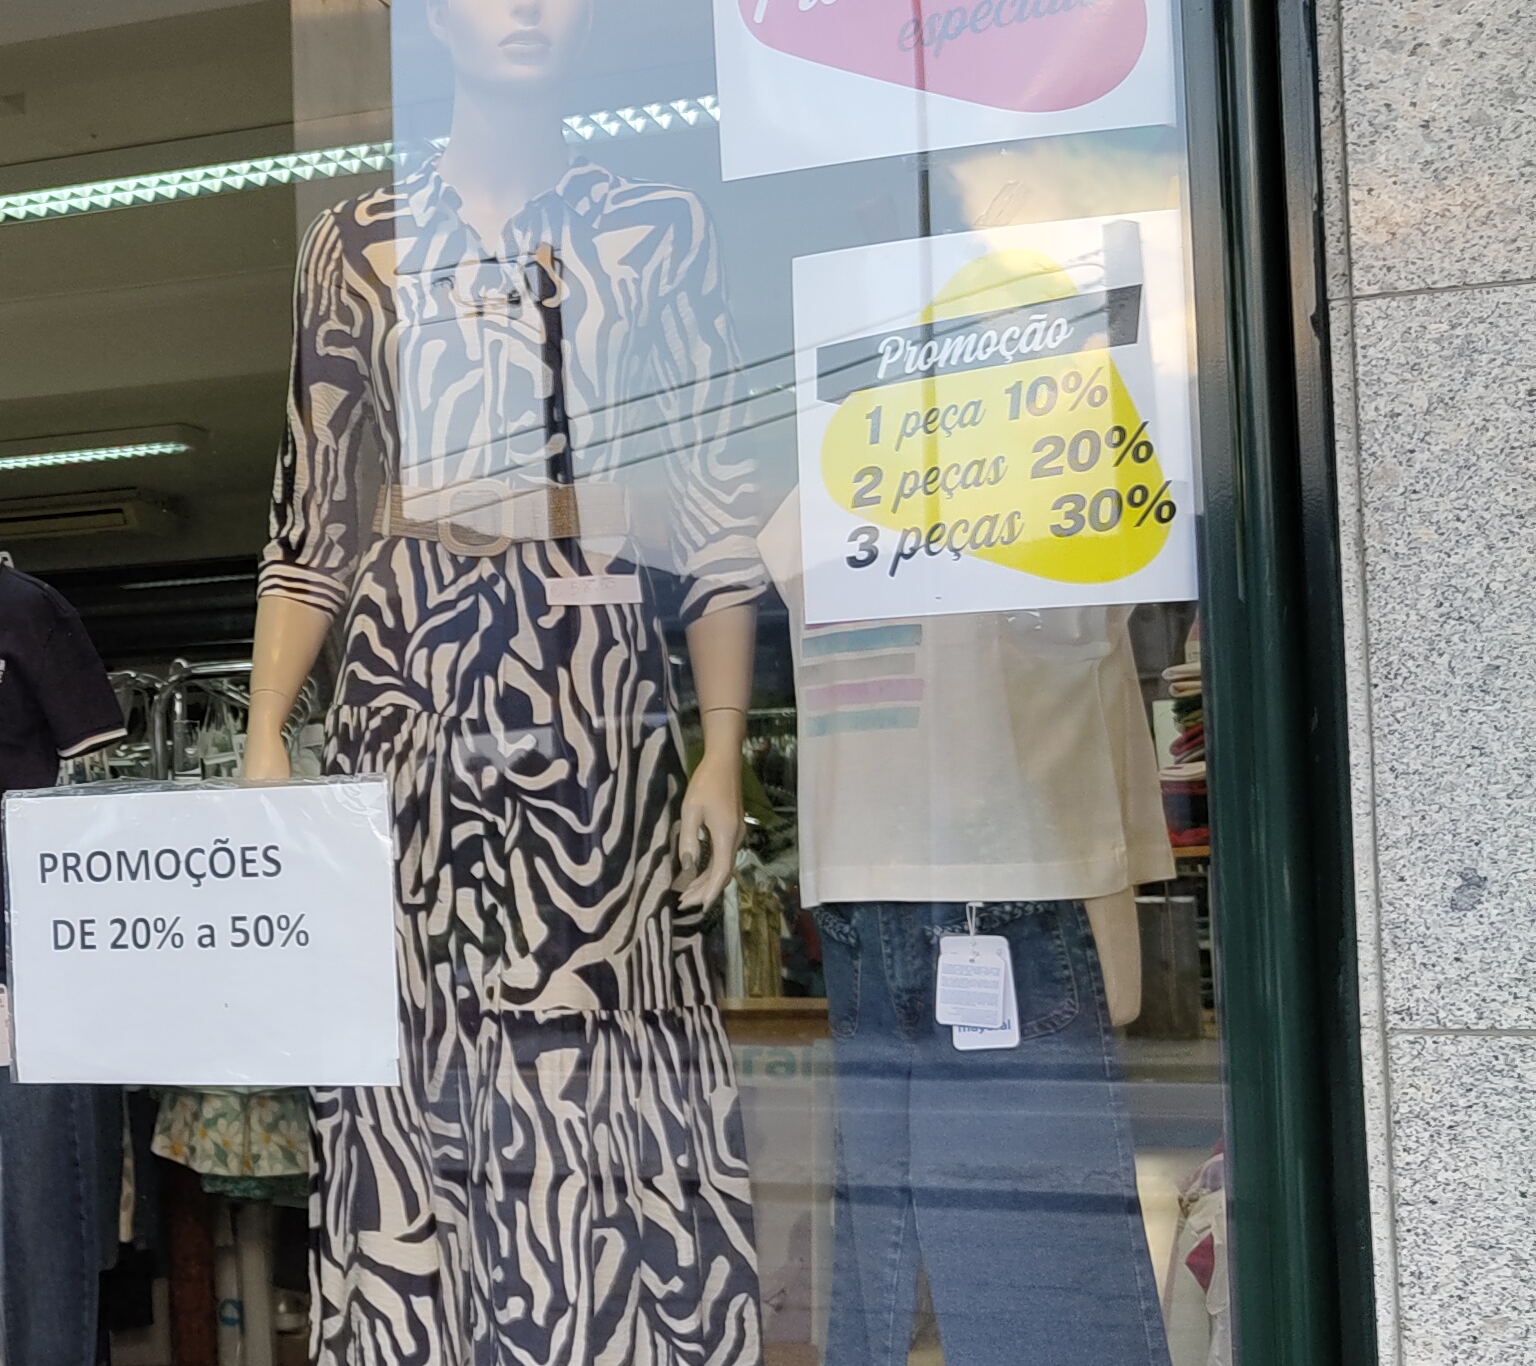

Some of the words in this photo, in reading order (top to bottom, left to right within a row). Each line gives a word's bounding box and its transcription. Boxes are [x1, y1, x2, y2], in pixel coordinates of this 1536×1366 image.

[876, 313, 1073, 379] Promoção
[865, 405, 882, 445] 1
[895, 398, 986, 452] peça
[1003, 366, 1109, 422] 10%
[851, 466, 884, 509] 2
[891, 454, 1008, 514] peças
[1030, 420, 1154, 481] 20%
[846, 525, 880, 569] 3
[888, 508, 1025, 577] peças
[1049, 480, 1177, 538] 30%
[39, 838, 283, 888] PROMOÇÕES
[52, 918, 97, 951] DE
[109, 916, 184, 950] 20%
[197, 925, 216, 948] a
[230, 913, 310, 947] 50%
